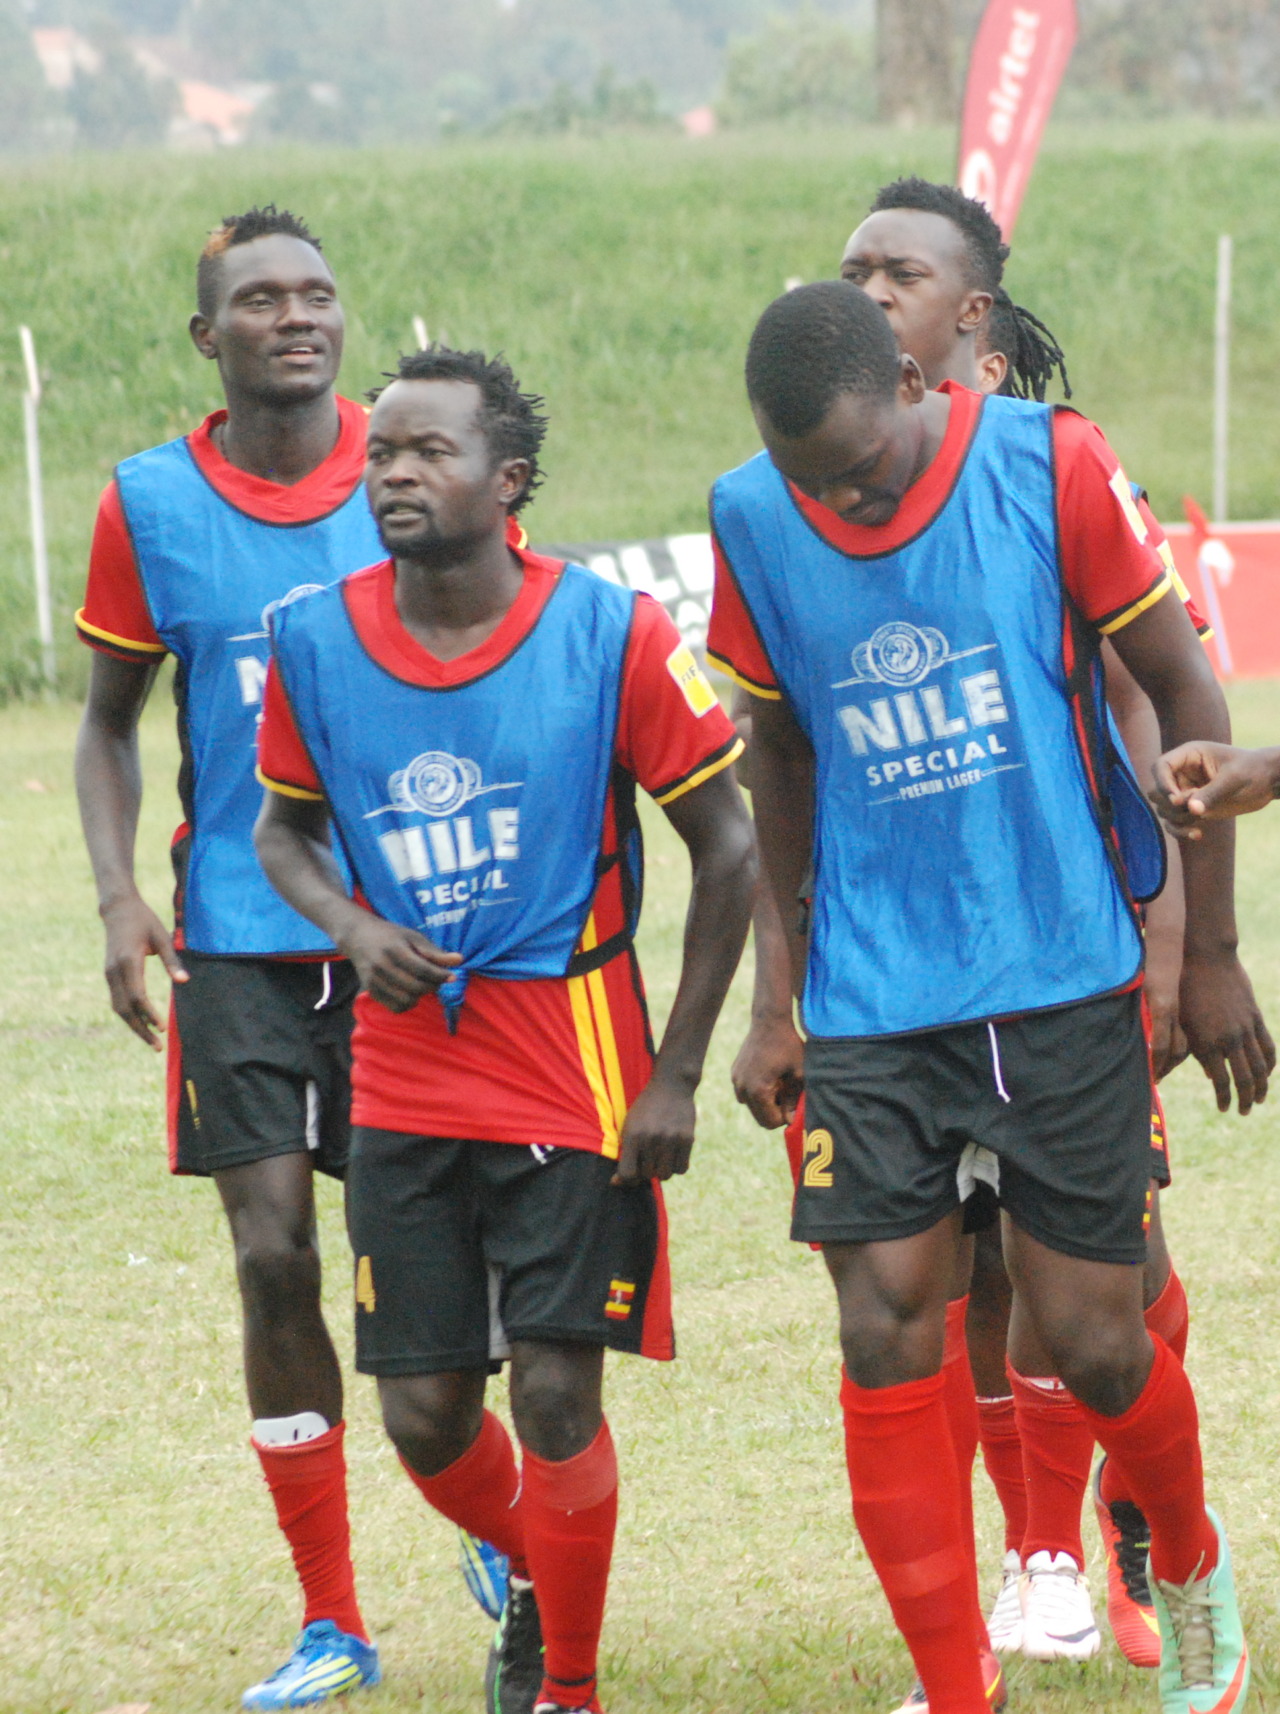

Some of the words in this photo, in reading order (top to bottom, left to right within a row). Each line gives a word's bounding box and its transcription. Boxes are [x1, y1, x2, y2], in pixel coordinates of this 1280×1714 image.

[987, 8, 1040, 145] airtel
[837, 669, 1009, 756] NILE
[866, 733, 1008, 787] SPECIAL
